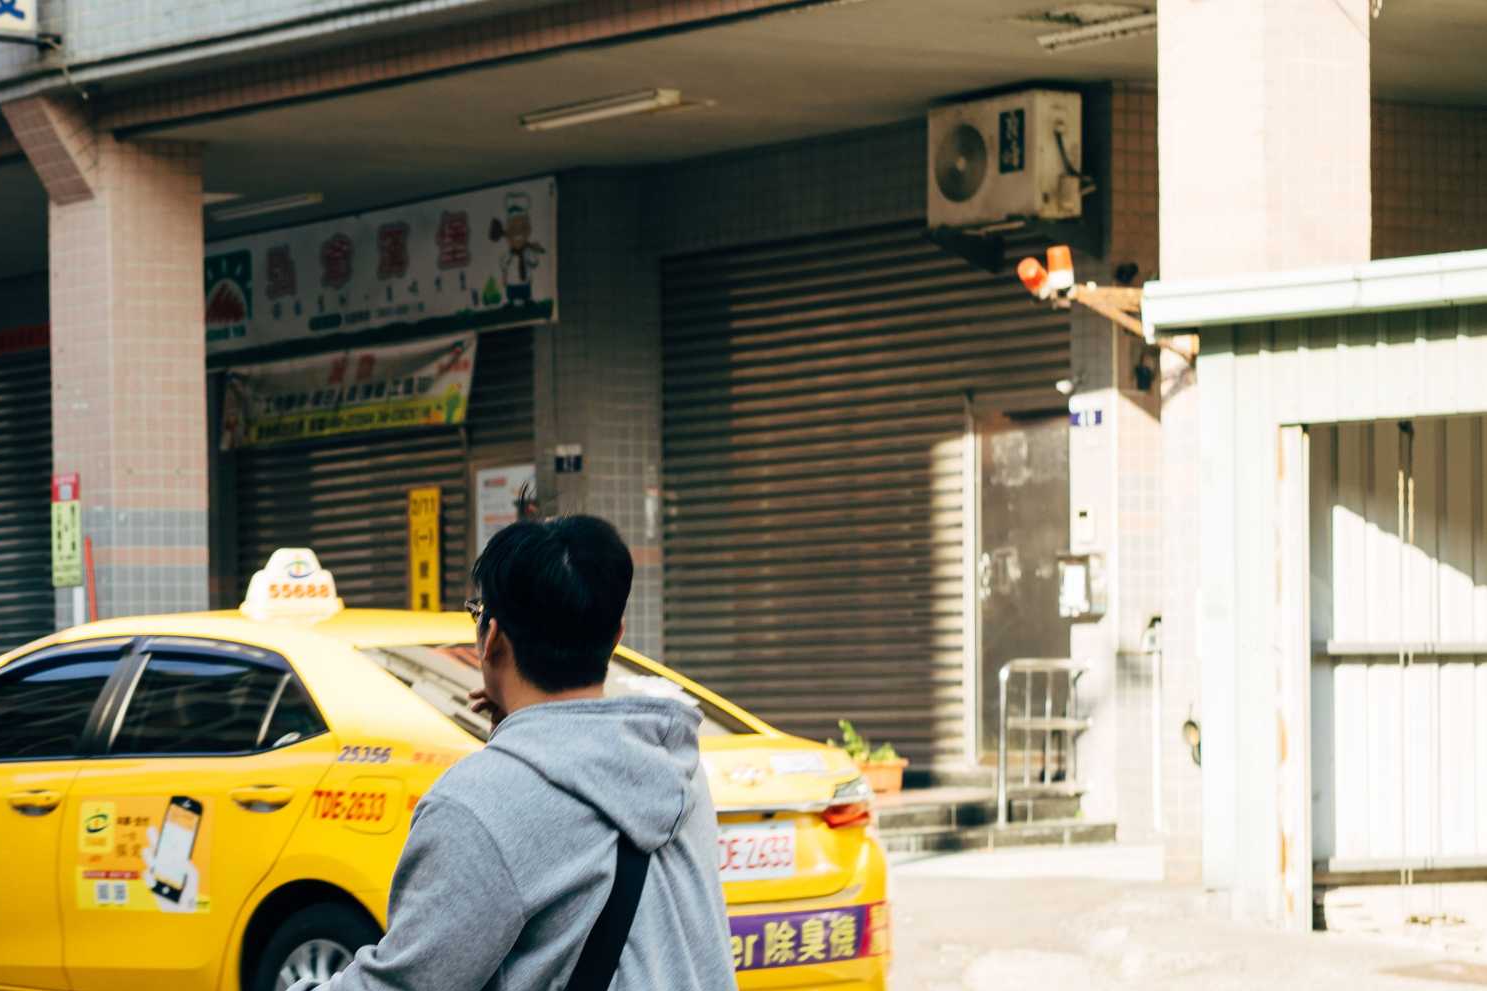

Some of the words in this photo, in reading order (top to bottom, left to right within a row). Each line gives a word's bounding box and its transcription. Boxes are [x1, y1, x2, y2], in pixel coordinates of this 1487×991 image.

[268, 583, 330, 599] 55688
[338, 744, 391, 764] 25356
[313, 789, 387, 821] TDE-2633
